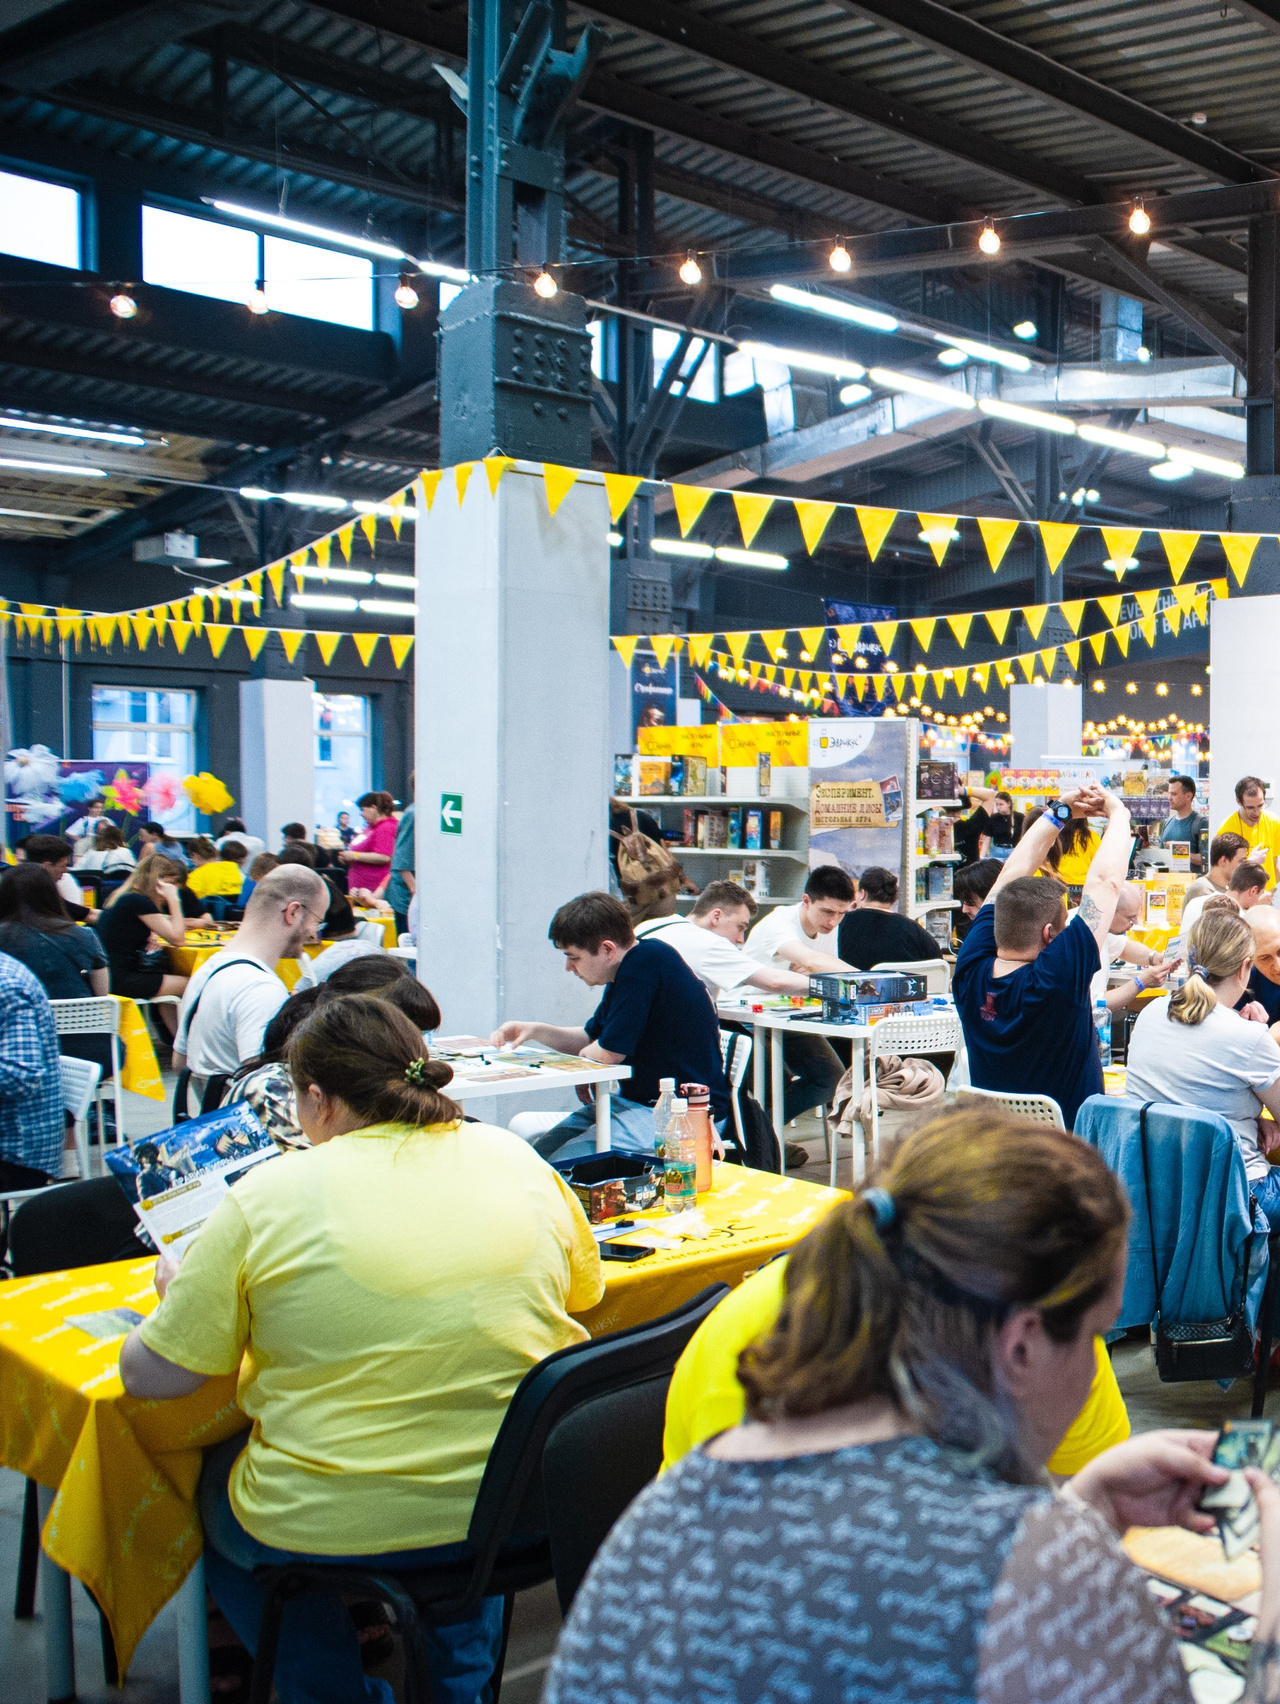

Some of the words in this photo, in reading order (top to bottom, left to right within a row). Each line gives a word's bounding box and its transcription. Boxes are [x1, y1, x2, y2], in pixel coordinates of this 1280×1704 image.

[1119, 602, 1144, 621] EVE
[815, 800, 857, 815] ДОМАШНИЕ
[859, 803, 883, 814] ЛИСЫ
